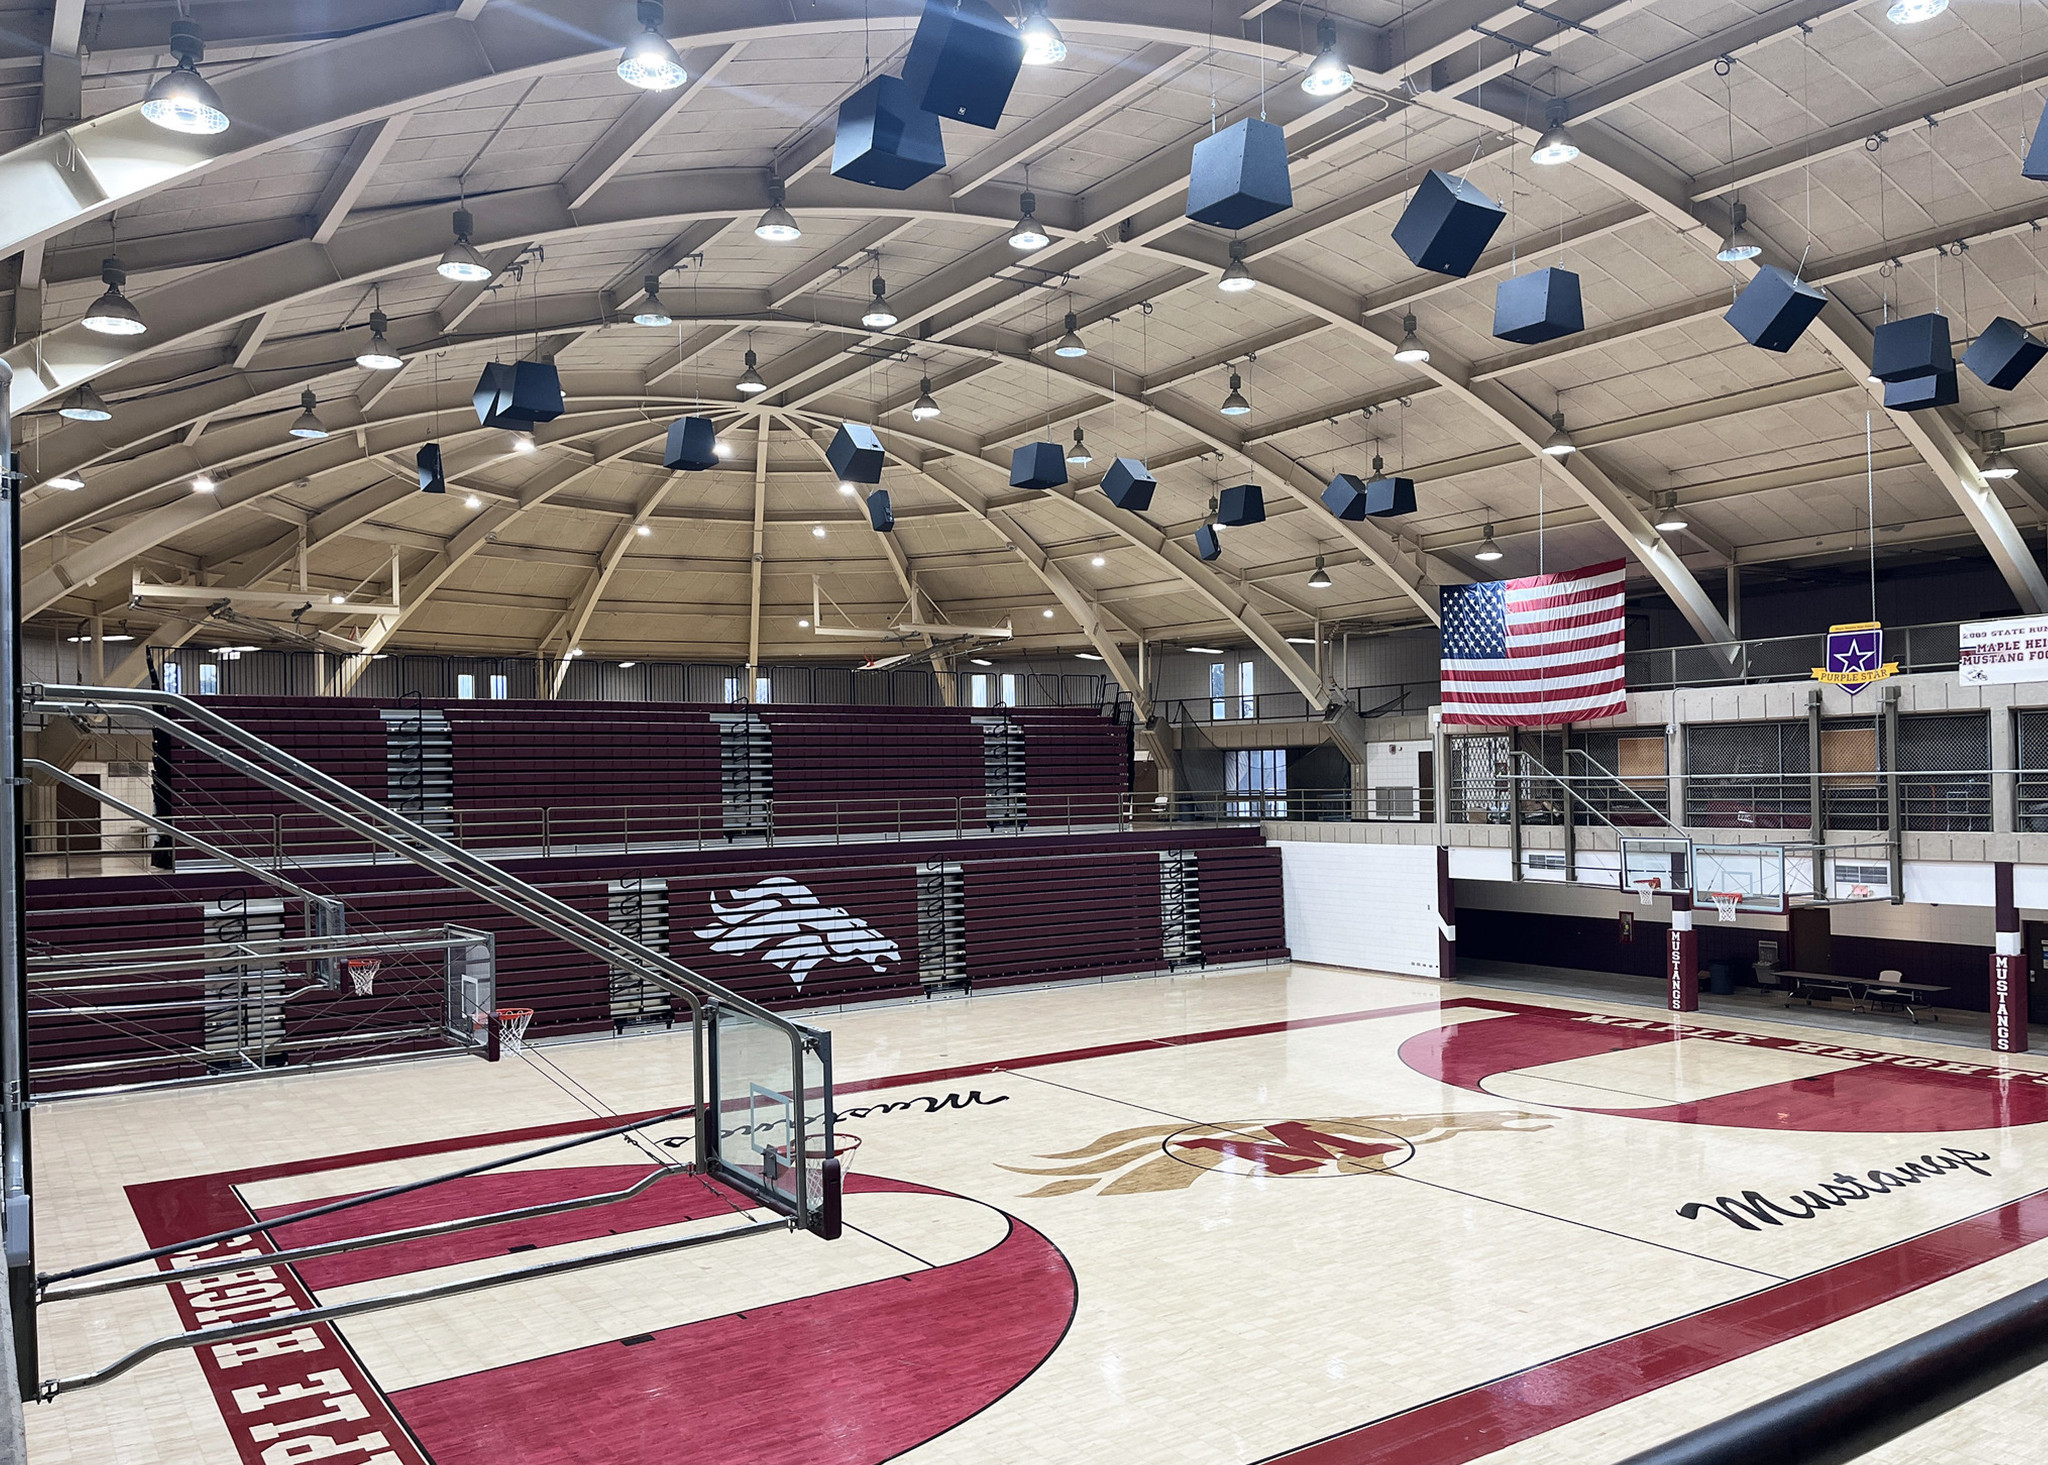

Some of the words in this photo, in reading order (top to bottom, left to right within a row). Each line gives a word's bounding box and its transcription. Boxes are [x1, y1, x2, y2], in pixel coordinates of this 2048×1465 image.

[1991, 627, 2025, 636] STATE
[1977, 641, 2020, 653] MAPLE
[2025, 638, 2047, 650] HEI
[1962, 652, 2024, 666] MUSTANG
[1820, 672, 1859, 682] PURPLE
[1861, 669, 1888, 681] STAR
[1671, 931, 1681, 1010] MUSTANGS
[1995, 956, 2009, 1051] MUSTANGS
[1570, 1014, 1770, 1043] MAPLE
[1675, 1147, 1992, 1231] Mustangs
